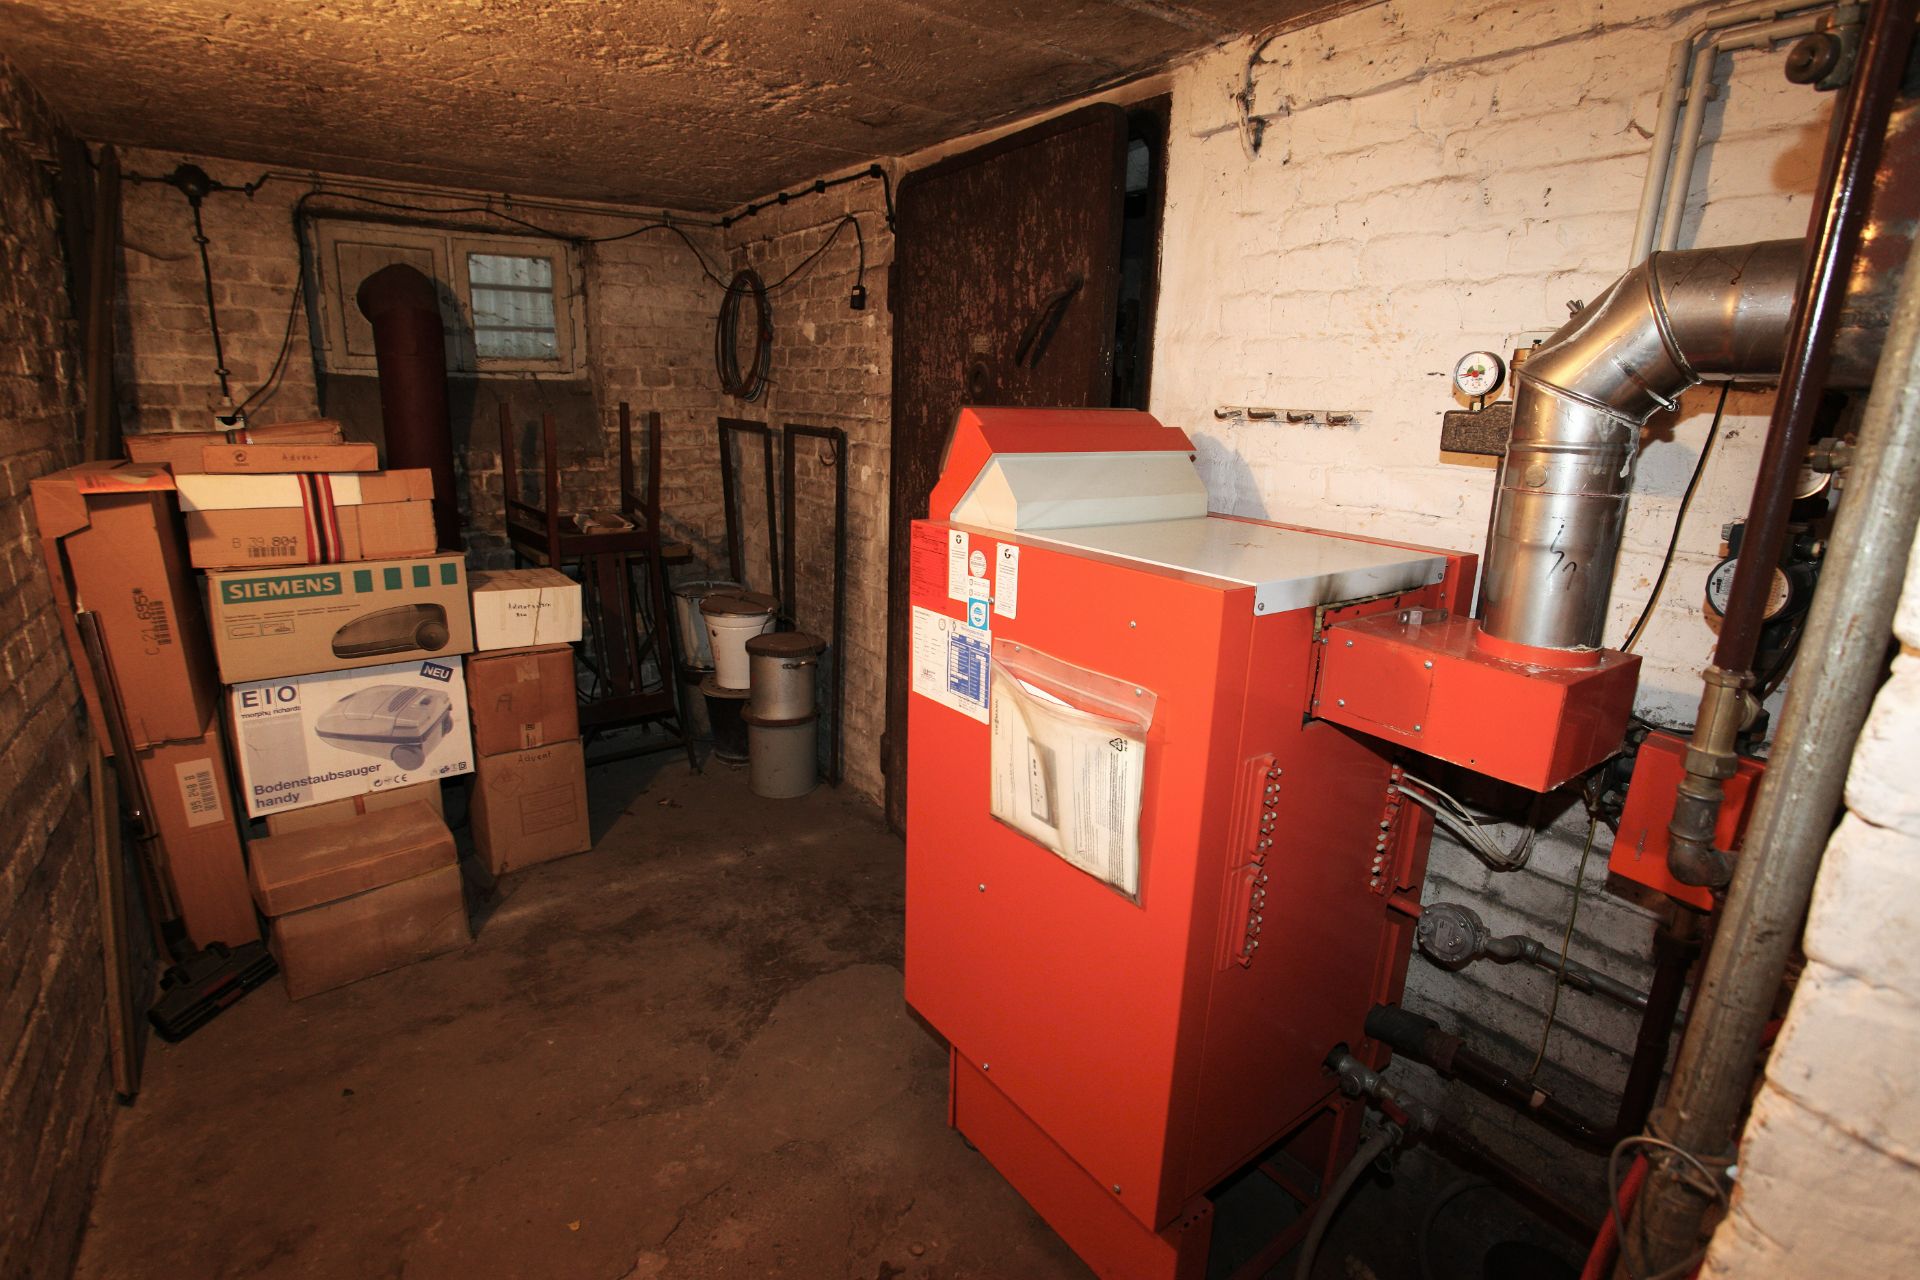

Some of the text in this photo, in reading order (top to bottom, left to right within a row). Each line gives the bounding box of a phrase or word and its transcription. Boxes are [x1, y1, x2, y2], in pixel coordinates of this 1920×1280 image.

[272, 536, 298, 546] 804
[229, 577, 336, 600] SIEMENS
[424, 665, 450, 679] NEU
[242, 685, 297, 708] EIO
[241, 705, 302, 720] morphy richards
[518, 752, 552, 763] Advent
[254, 764, 382, 795] Bodenstaubsauger
[255, 793, 300, 809] handy
